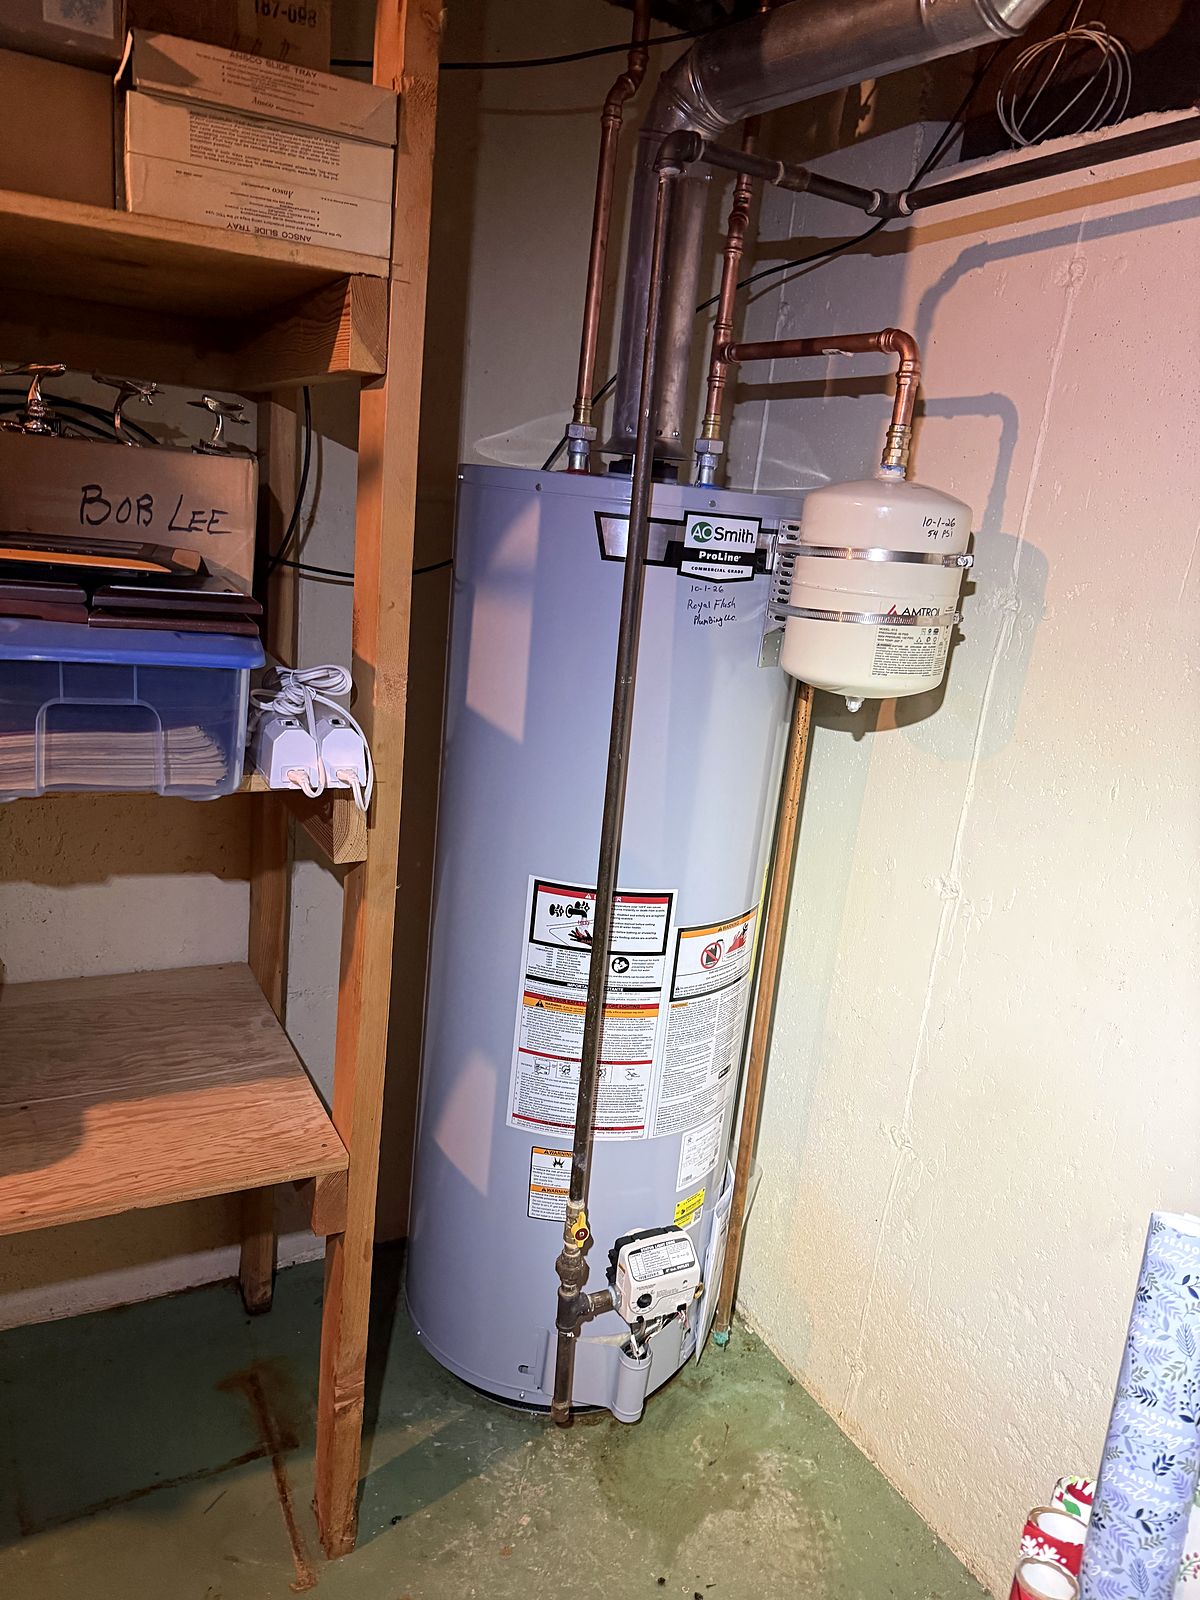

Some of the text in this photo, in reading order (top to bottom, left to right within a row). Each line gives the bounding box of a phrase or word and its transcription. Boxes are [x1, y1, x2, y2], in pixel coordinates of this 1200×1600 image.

[295, 66, 318, 79] TRAY
[226, 222, 312, 242] ANSCO SLIDE TRAY
[80, 484, 232, 535] BOB LEE
[922, 516, 956, 528] 10-1-26
[927, 529, 939, 540] 54
[698, 550, 741, 562] ProLine
[691, 565, 726, 574] COMMERCIAL
[690, 584, 724, 593] 10-1-26
[686, 598, 711, 614] Royal
[1163, 1235, 1200, 1256] SEASO
